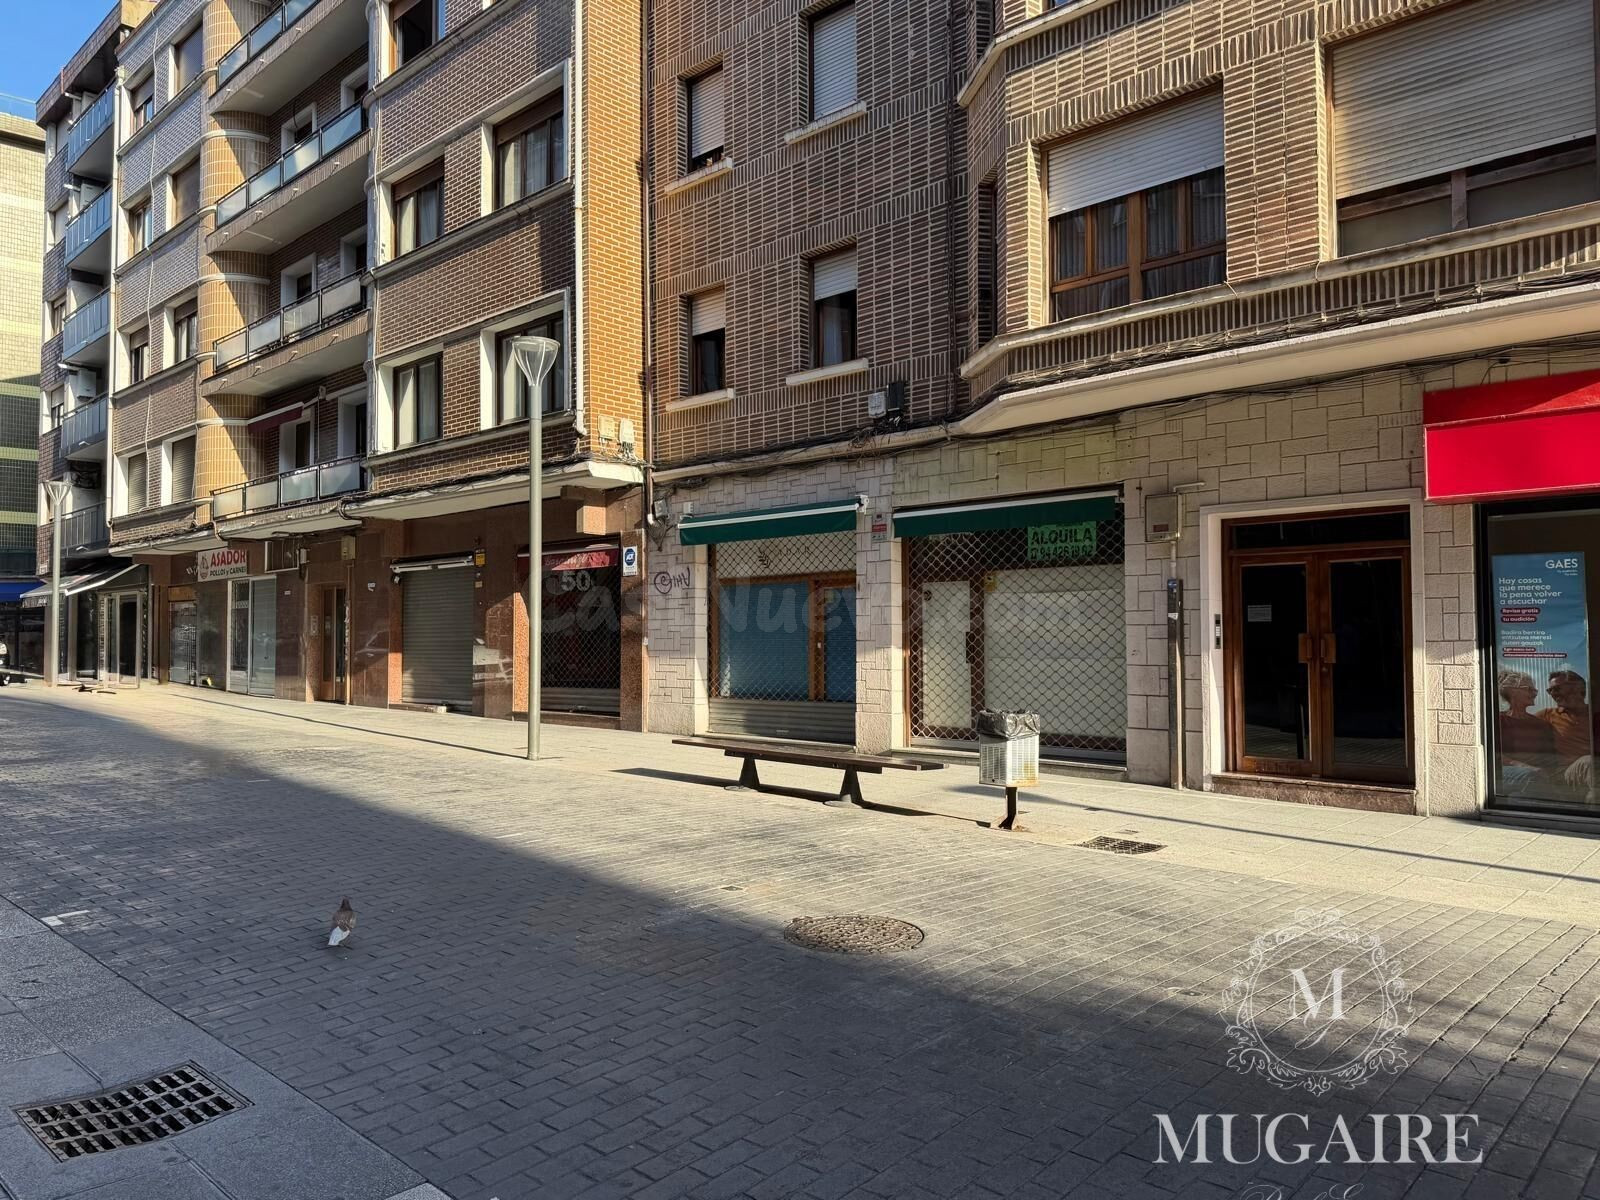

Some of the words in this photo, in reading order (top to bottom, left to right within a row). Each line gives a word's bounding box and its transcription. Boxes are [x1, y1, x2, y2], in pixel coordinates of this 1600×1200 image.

[1031, 527, 1093, 545] ALQUILA
[211, 549, 246, 567] ASADOR
[1545, 558, 1578, 569] GAES
[210, 569, 226, 577] POLLOS
[1499, 577, 1516, 585] Hay
[1507, 597, 1547, 605] escuchar
